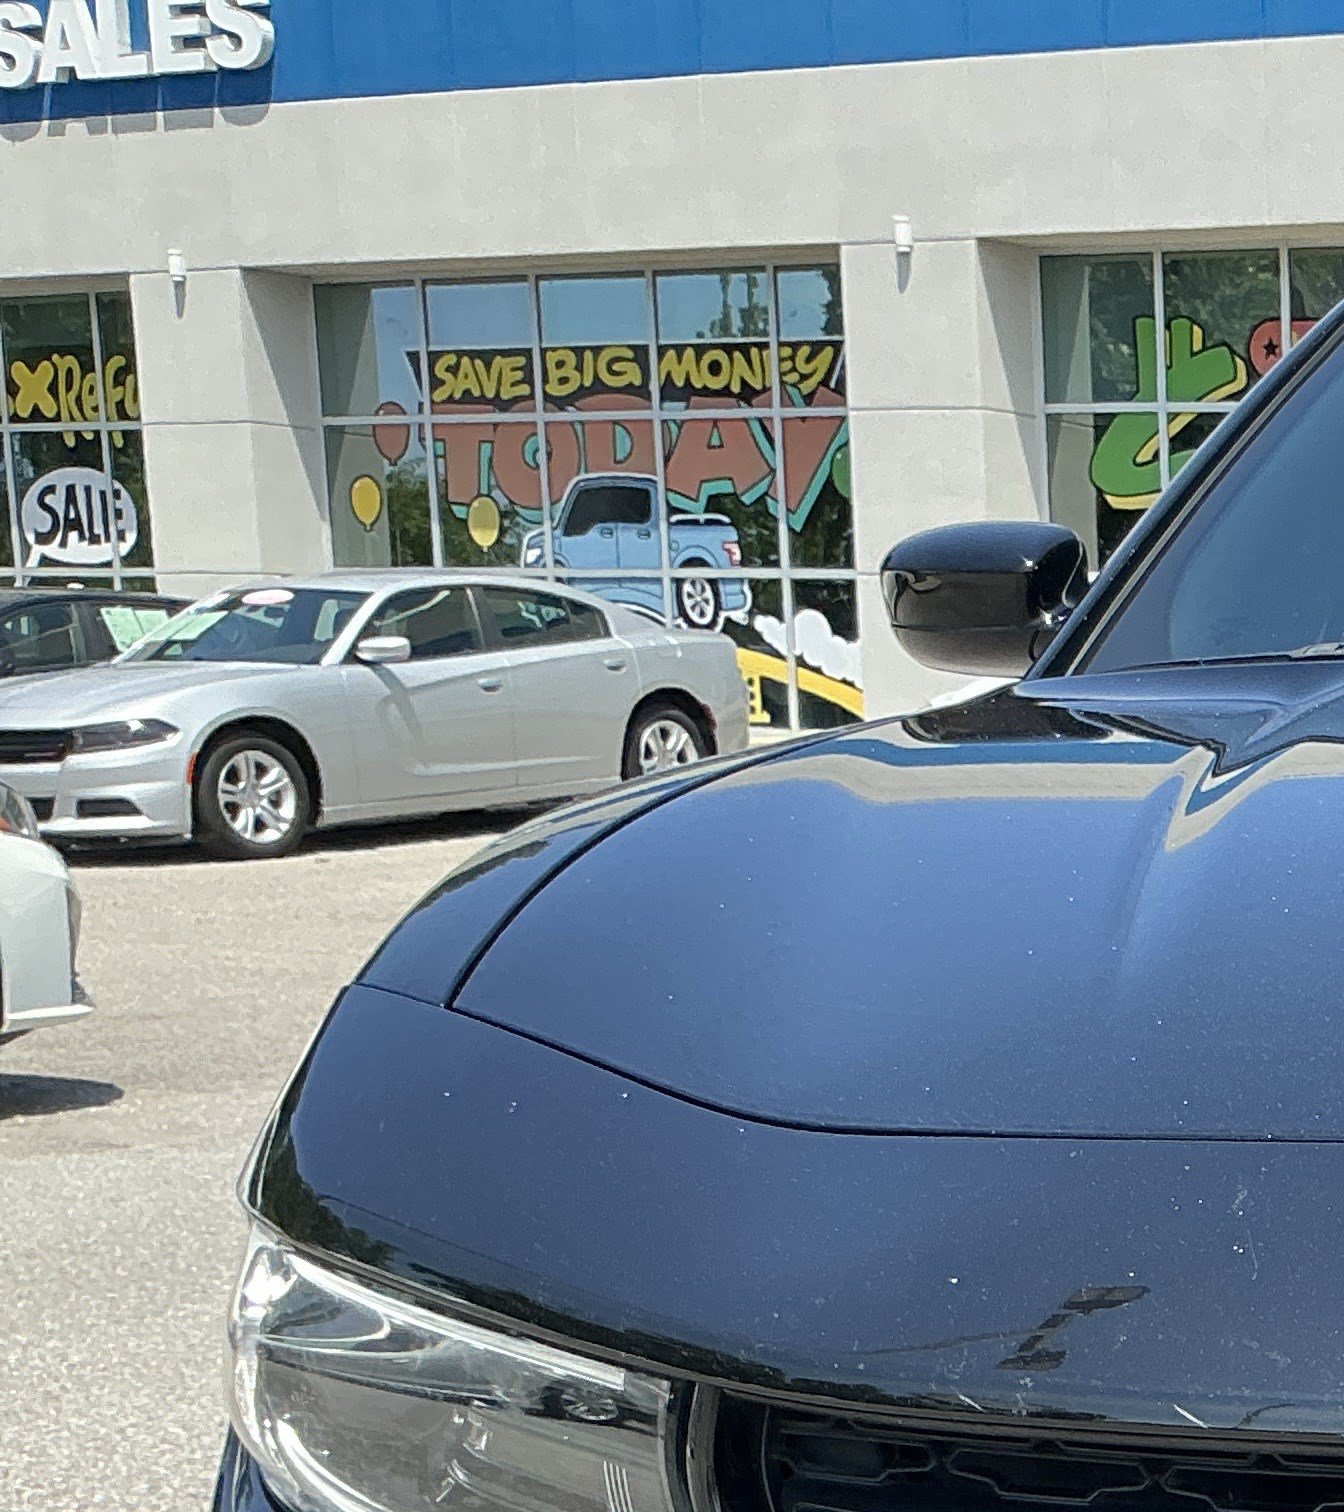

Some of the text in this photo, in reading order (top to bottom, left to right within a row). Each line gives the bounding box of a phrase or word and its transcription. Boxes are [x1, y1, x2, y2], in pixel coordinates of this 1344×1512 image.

[0, 0, 274, 88] SALES
[434, 345, 836, 401] SAVE BIG MONEY
[421, 388, 848, 522] TODAY
[34, 483, 127, 548] SALE
